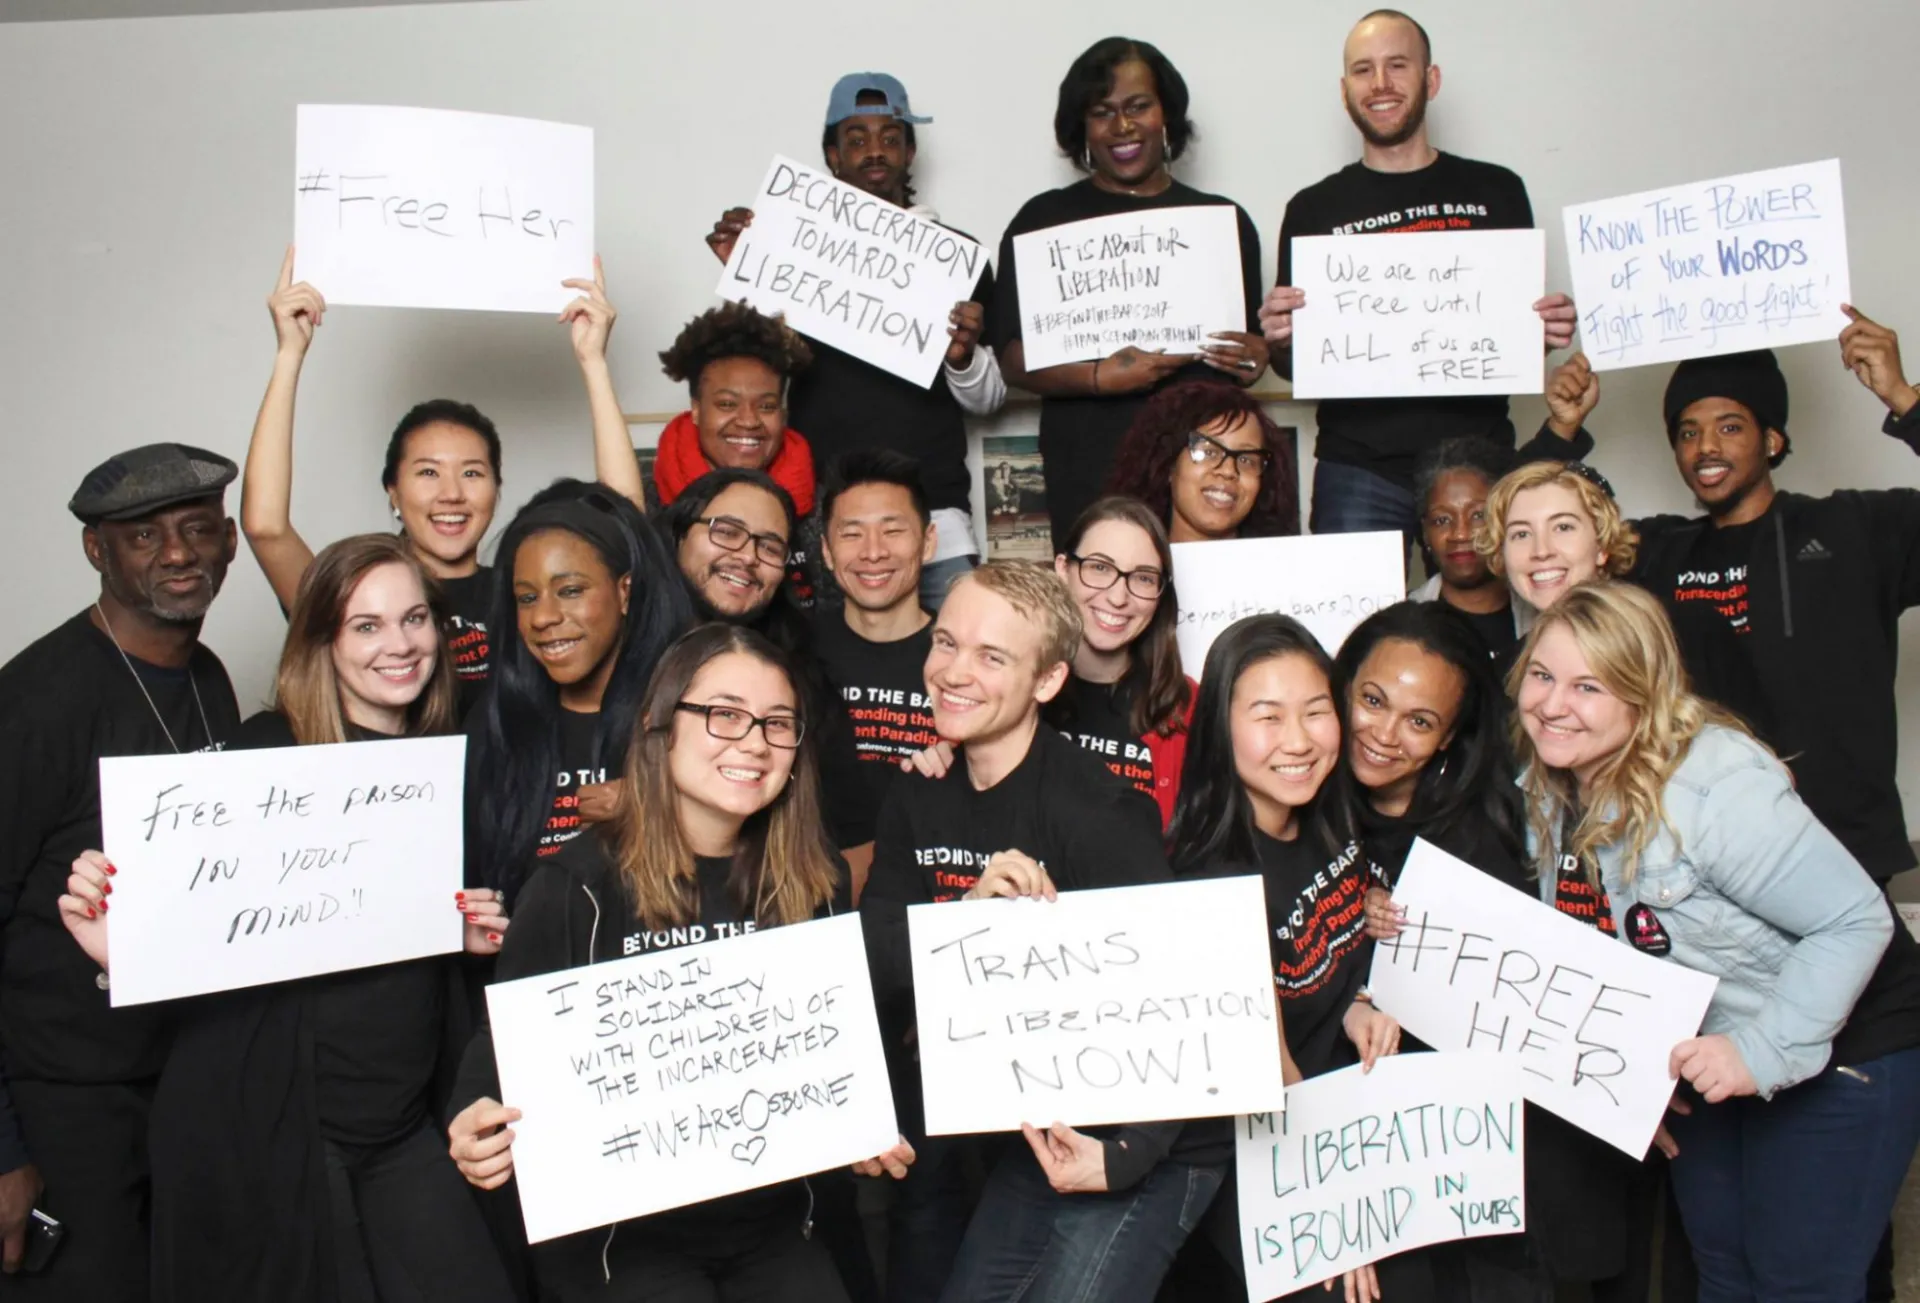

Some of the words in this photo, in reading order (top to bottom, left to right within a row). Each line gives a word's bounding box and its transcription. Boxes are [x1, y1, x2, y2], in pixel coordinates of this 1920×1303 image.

[298, 168, 455, 237] #Free
[478, 186, 574, 240] Her
[767, 163, 979, 279] DECARCERATION
[1332, 212, 1402, 235] BEYOND
[1405, 204, 1438, 220] THE
[1443, 203, 1488, 216] BARS
[1448, 217, 1471, 228] the
[1578, 213, 1644, 255] KNOW
[1645, 198, 1700, 238] THE
[1704, 183, 1817, 230] POWER
[792, 217, 916, 289] TOWARDS
[1325, 254, 1371, 283] We
[1384, 263, 1416, 282] are
[1428, 256, 1473, 283] not
[1659, 249, 1712, 283] YOUR
[1717, 236, 1808, 277] WORDS
[734, 243, 933, 354] LIBERATION
[1334, 290, 1409, 315] Free
[1584, 304, 1643, 361] Fight
[1652, 293, 1688, 333] the
[1700, 283, 1749, 349] good
[1320, 333, 1391, 364] ALL
[1411, 329, 1435, 353] of
[1439, 337, 1458, 352] us
[1470, 337, 1498, 352] are
[1417, 356, 1519, 382] FREE
[867, 687, 905, 704] THE
[909, 693, 933, 708] BA
[911, 713, 935, 727] the
[879, 726, 938, 746] Paradig
[1078, 734, 1119, 755] THE
[1124, 743, 1153, 763] BA
[576, 767, 606, 786] TH
[1124, 764, 1153, 780] the
[623, 925, 707, 955] BEYOND
[713, 921, 757, 941] THE
[931, 927, 1141, 985] TRANS
[547, 981, 580, 1016] I
[595, 968, 674, 1008] STAND
[680, 956, 713, 986] IN
[595, 972, 767, 1038] SOLIDARITY
[1379, 905, 1652, 1054] #FREE
[570, 1042, 635, 1077] WITH
[648, 997, 796, 1060] CHILDREN
[807, 984, 844, 1014] OF
[947, 987, 1271, 1042] LIBERATION
[588, 1070, 640, 1105] THE
[658, 1022, 840, 1091] INCARCERATED
[1010, 1033, 1220, 1096] NOW!
[1467, 1001, 1627, 1107] HER
[1271, 1101, 1516, 1198] LIBERATION
[1255, 1224, 1283, 1265] IS
[1289, 1185, 1414, 1279] BOUND
[1434, 1172, 1467, 1199] IN
[1449, 1196, 1521, 1236] YOURS
